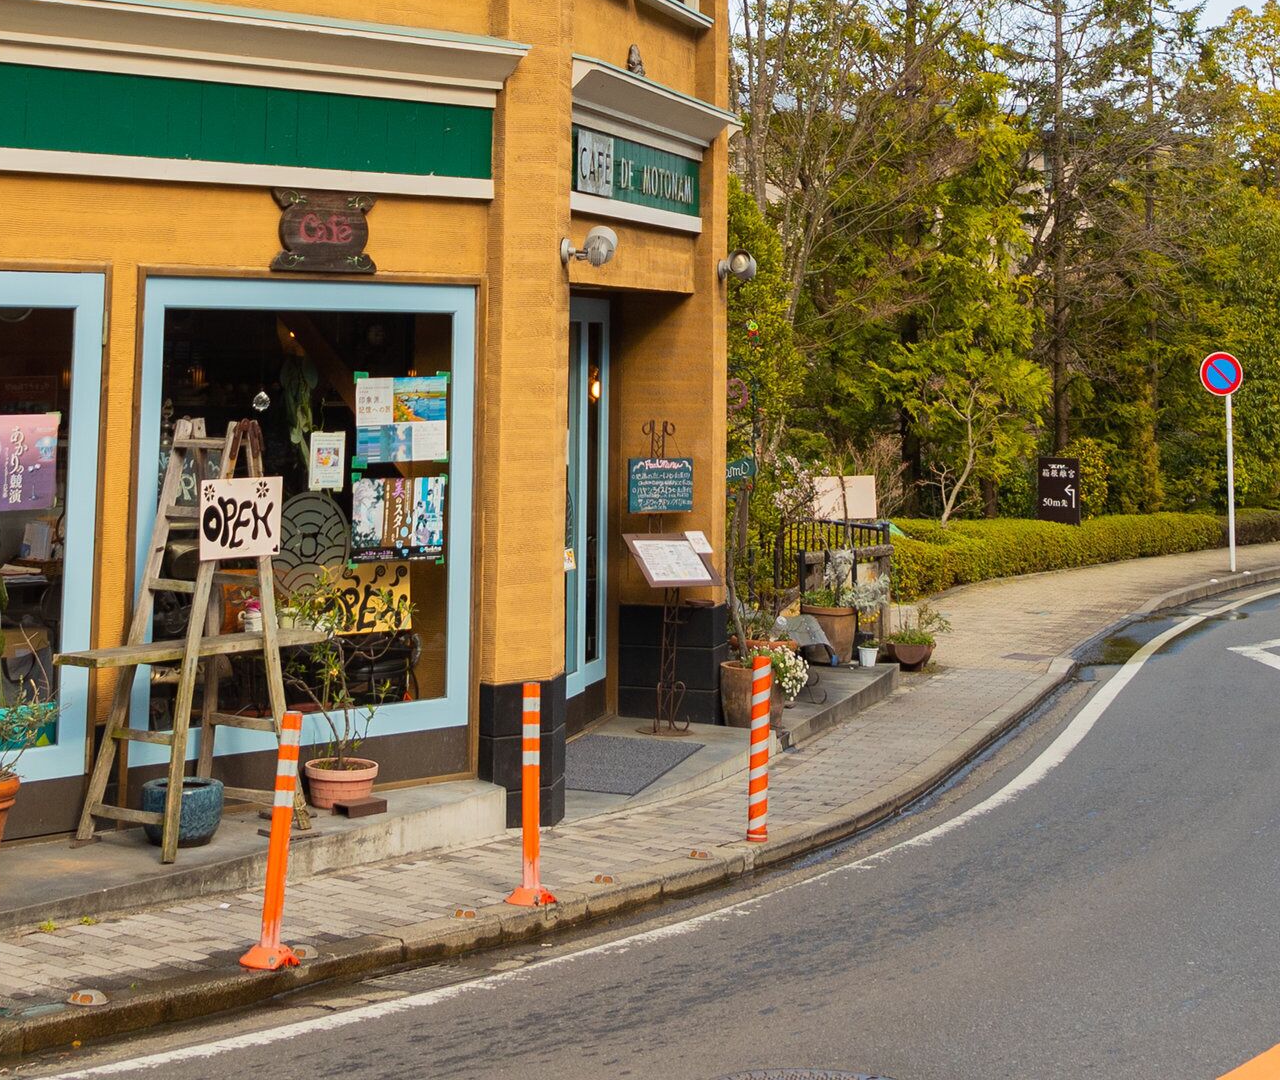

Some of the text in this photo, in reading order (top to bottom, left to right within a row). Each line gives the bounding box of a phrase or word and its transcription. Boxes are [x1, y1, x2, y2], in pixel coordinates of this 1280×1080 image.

[621, 157, 634, 190] DE
[642, 164, 694, 204] MOTONAMI
[203, 497, 273, 549] OPEN
